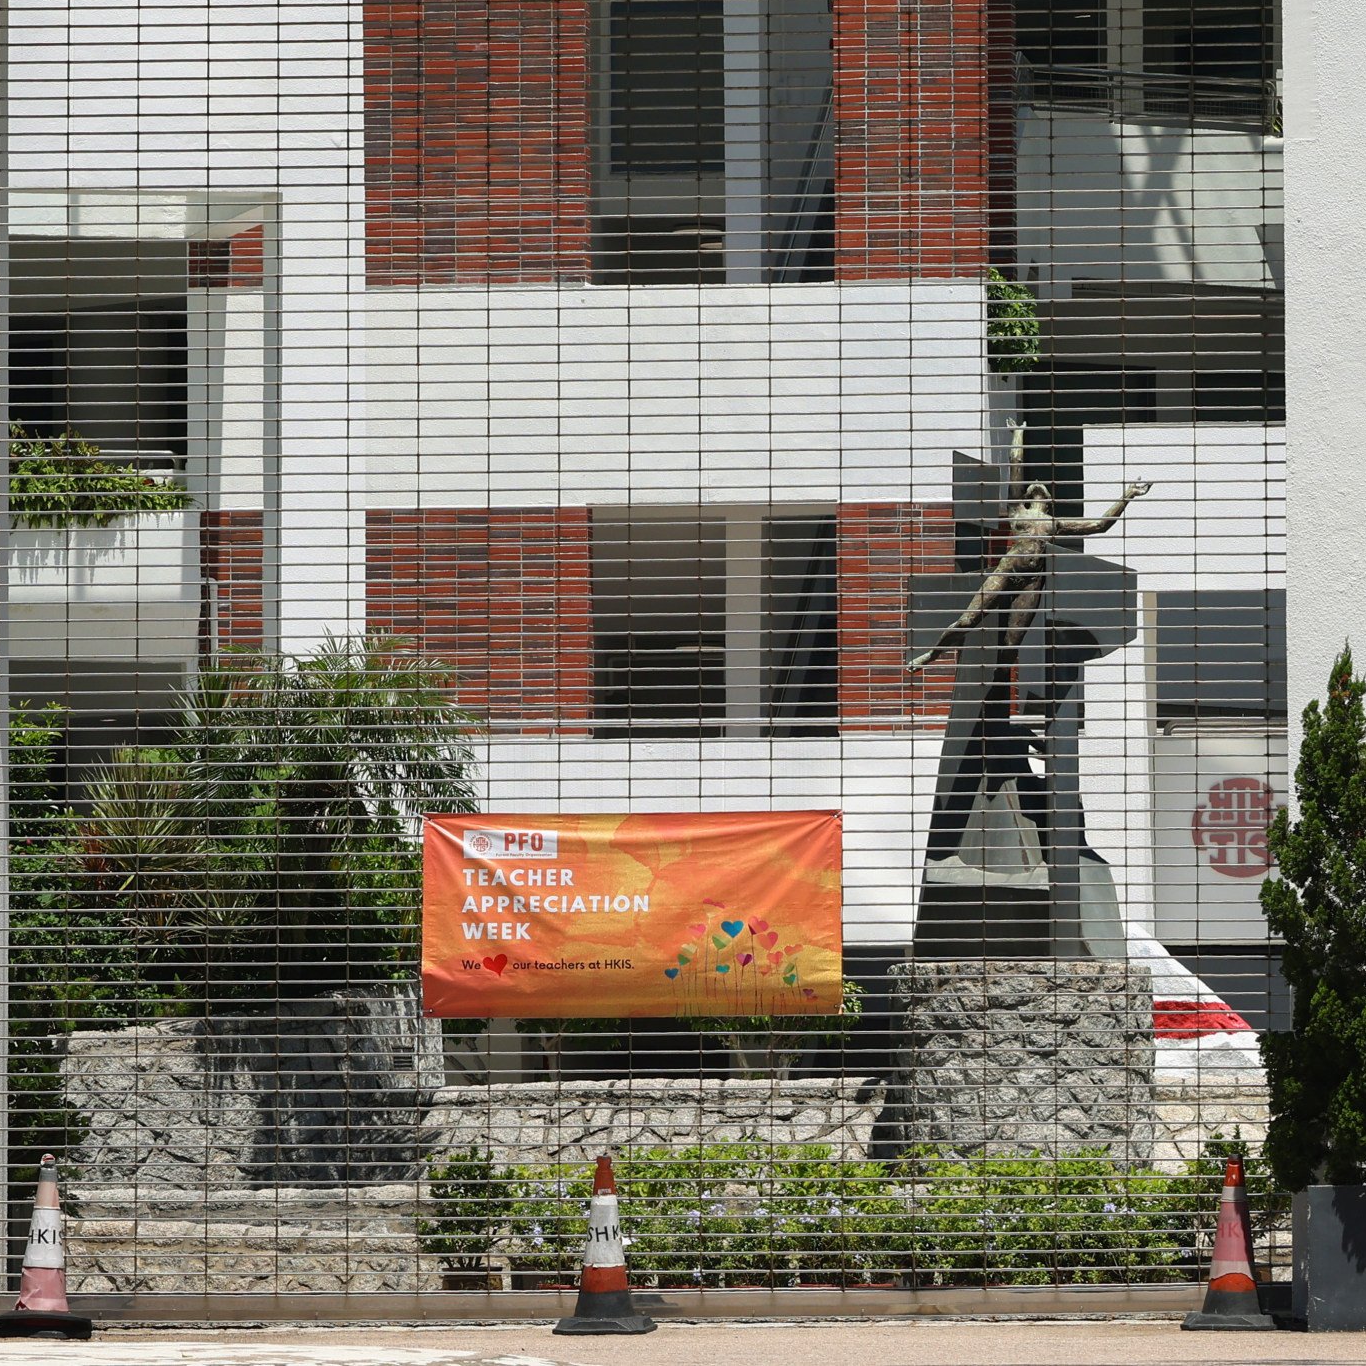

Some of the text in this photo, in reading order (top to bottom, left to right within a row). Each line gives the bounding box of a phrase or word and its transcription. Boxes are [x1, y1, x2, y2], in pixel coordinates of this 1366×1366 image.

[504, 833, 543, 851] PFO
[462, 868, 574, 886] TEACHER
[462, 895, 649, 913] APPRECIATION
[462, 922, 531, 940] WEEK
[462, 958, 635, 970] We our teachers at HKIS.
